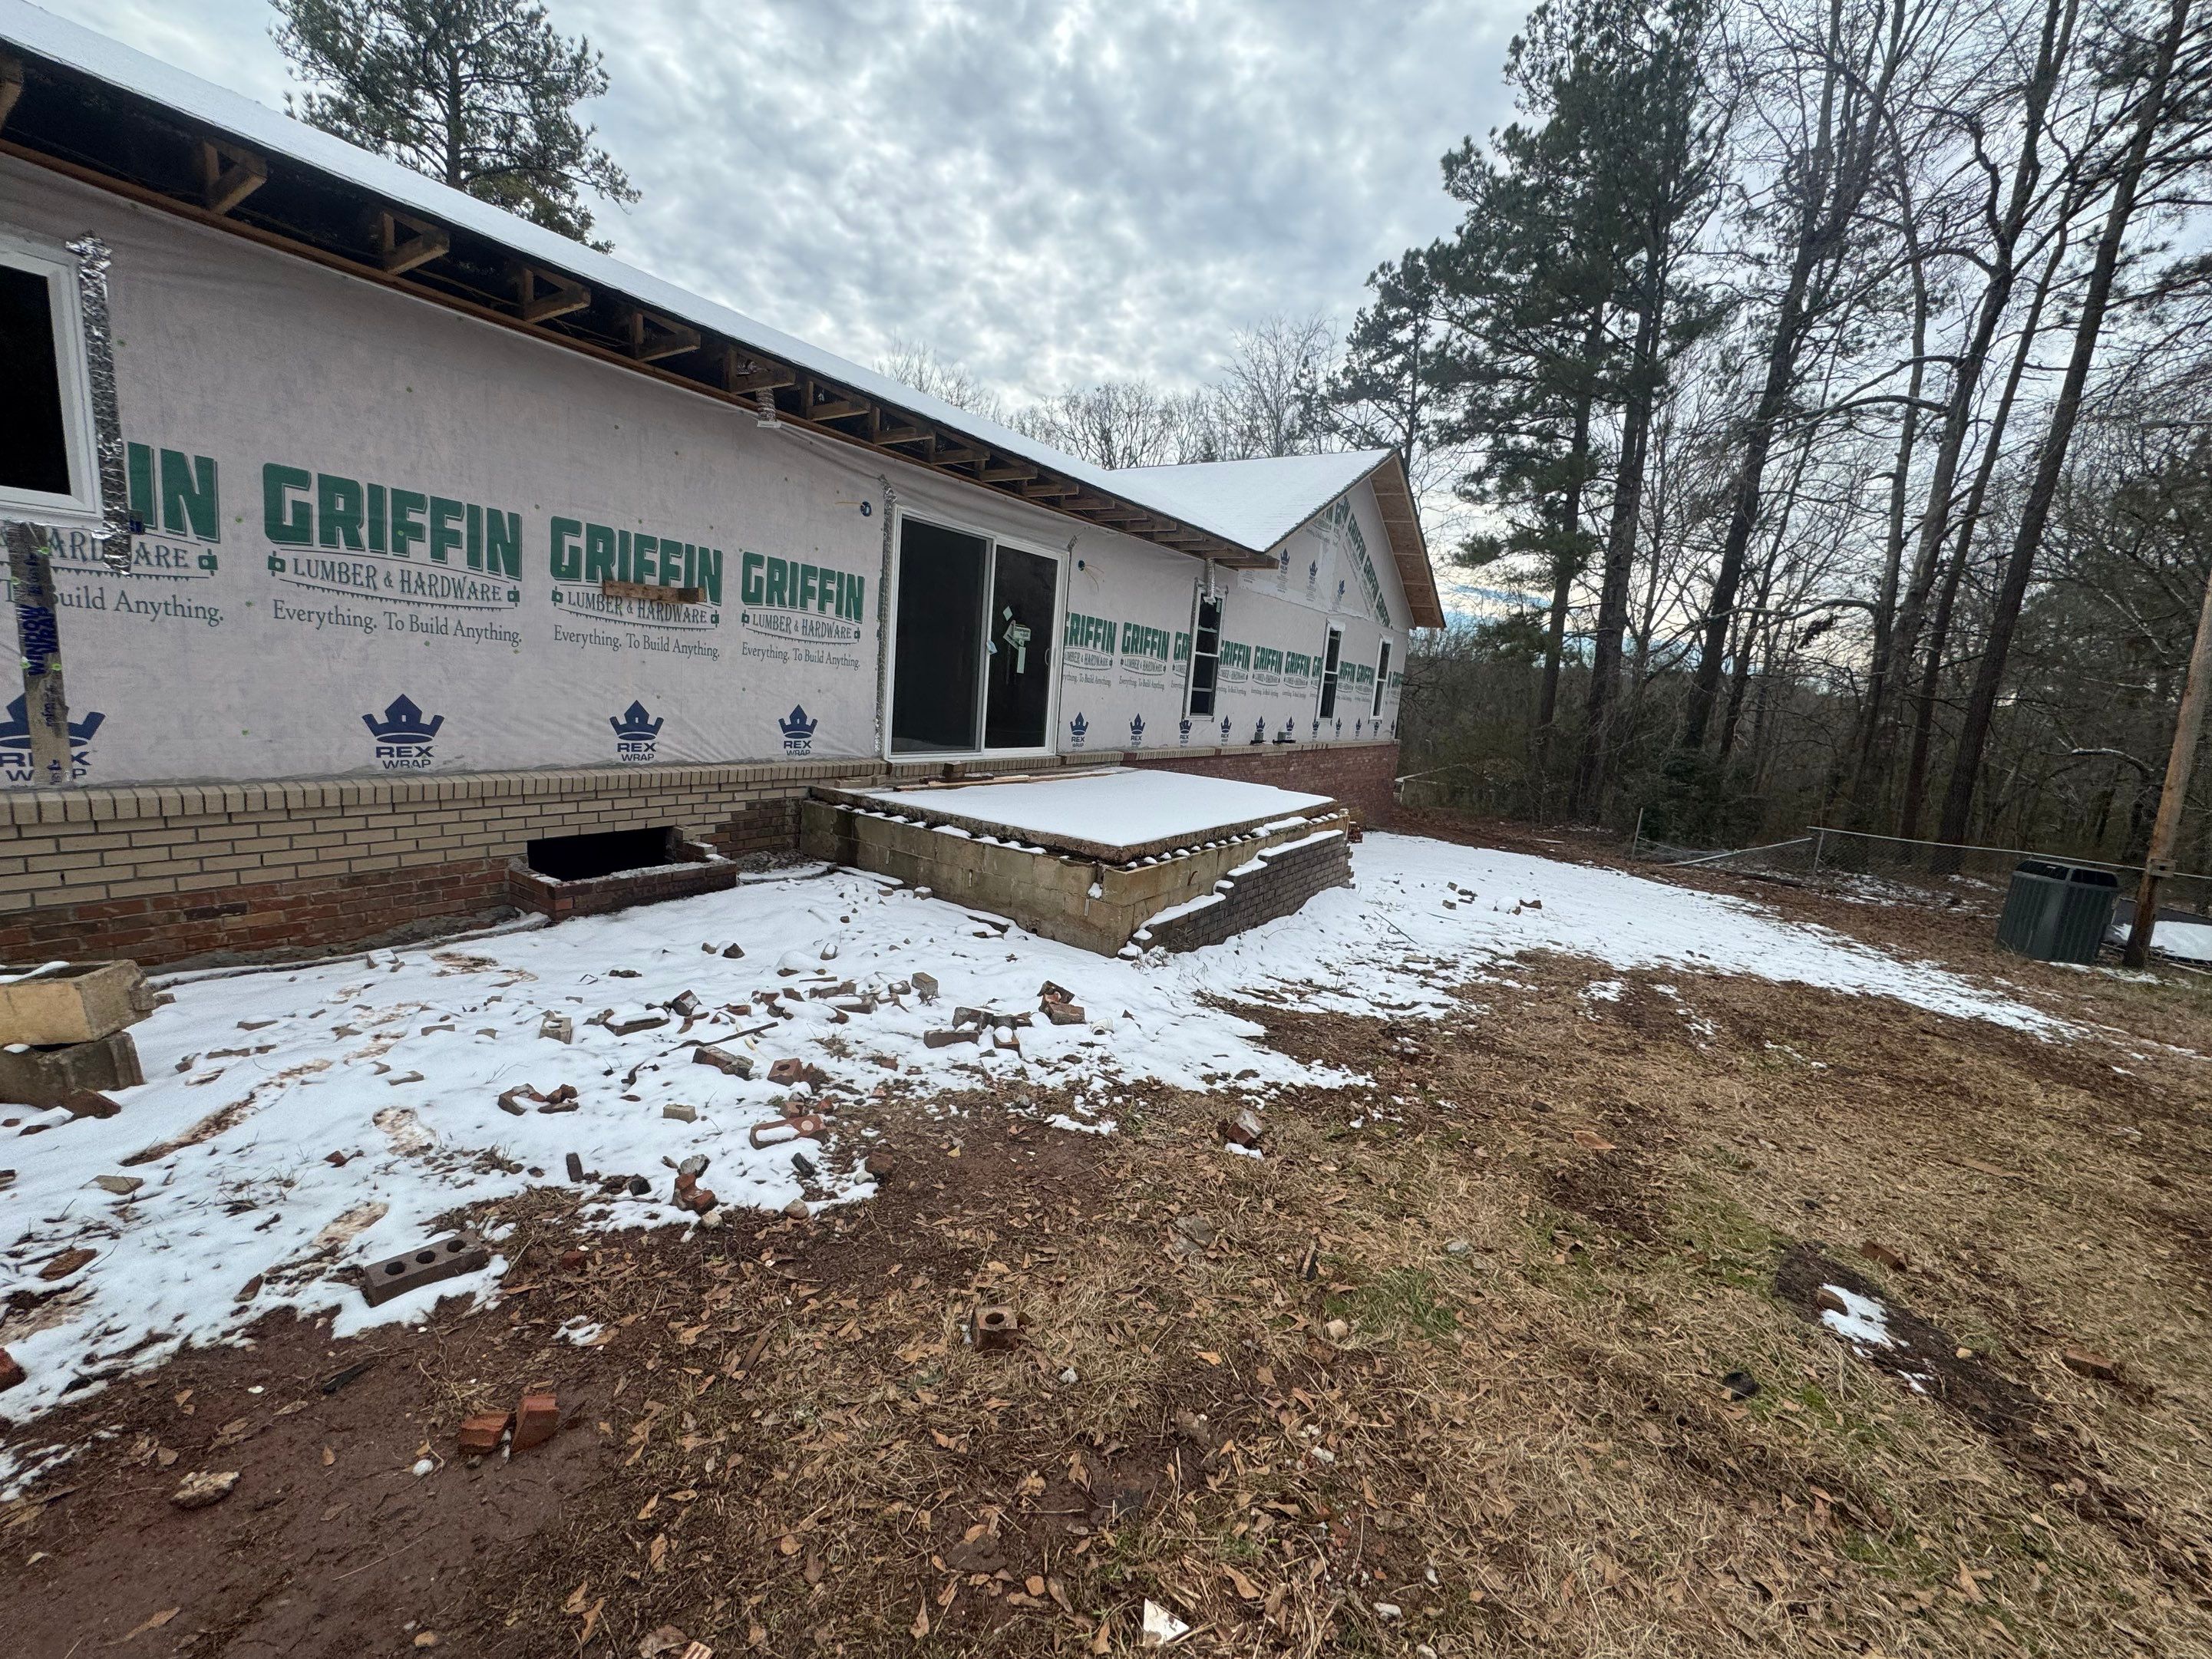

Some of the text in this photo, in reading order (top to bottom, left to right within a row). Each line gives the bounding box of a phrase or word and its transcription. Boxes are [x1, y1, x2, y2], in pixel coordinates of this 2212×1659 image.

[262, 463, 523, 582] GRIFFIN
[1348, 512, 1366, 565] GRIFFIN
[48, 528, 190, 569] ARDARE
[550, 516, 723, 606] GRIFFIN
[293, 558, 501, 602] LUMBER & HARDWARE
[741, 551, 864, 624] GRIFFIN
[114, 590, 224, 627] Anything.
[273, 599, 522, 647] Everything. To Build Anything.
[567, 592, 707, 624] LUMBER & HARDWARE
[18, 604, 46, 676] WINDOW
[553, 625, 720, 661] Everything. To Build Anything.
[752, 614, 852, 640] LUMBER & HARDWARE
[1121, 622, 1170, 662] GRIFFIN
[741, 642, 860, 670] Everything. To Build Anything.
[1253, 645, 1283, 675] GRIFFIN
[1285, 651, 1311, 678] GRIFFIN
[0, 751, 91, 767] RX
[376, 746, 434, 758] REX
[617, 743, 656, 752] REX
[784, 740, 812, 749] REX
[6, 769, 87, 781] WP
[382, 759, 431, 768] WRAP
